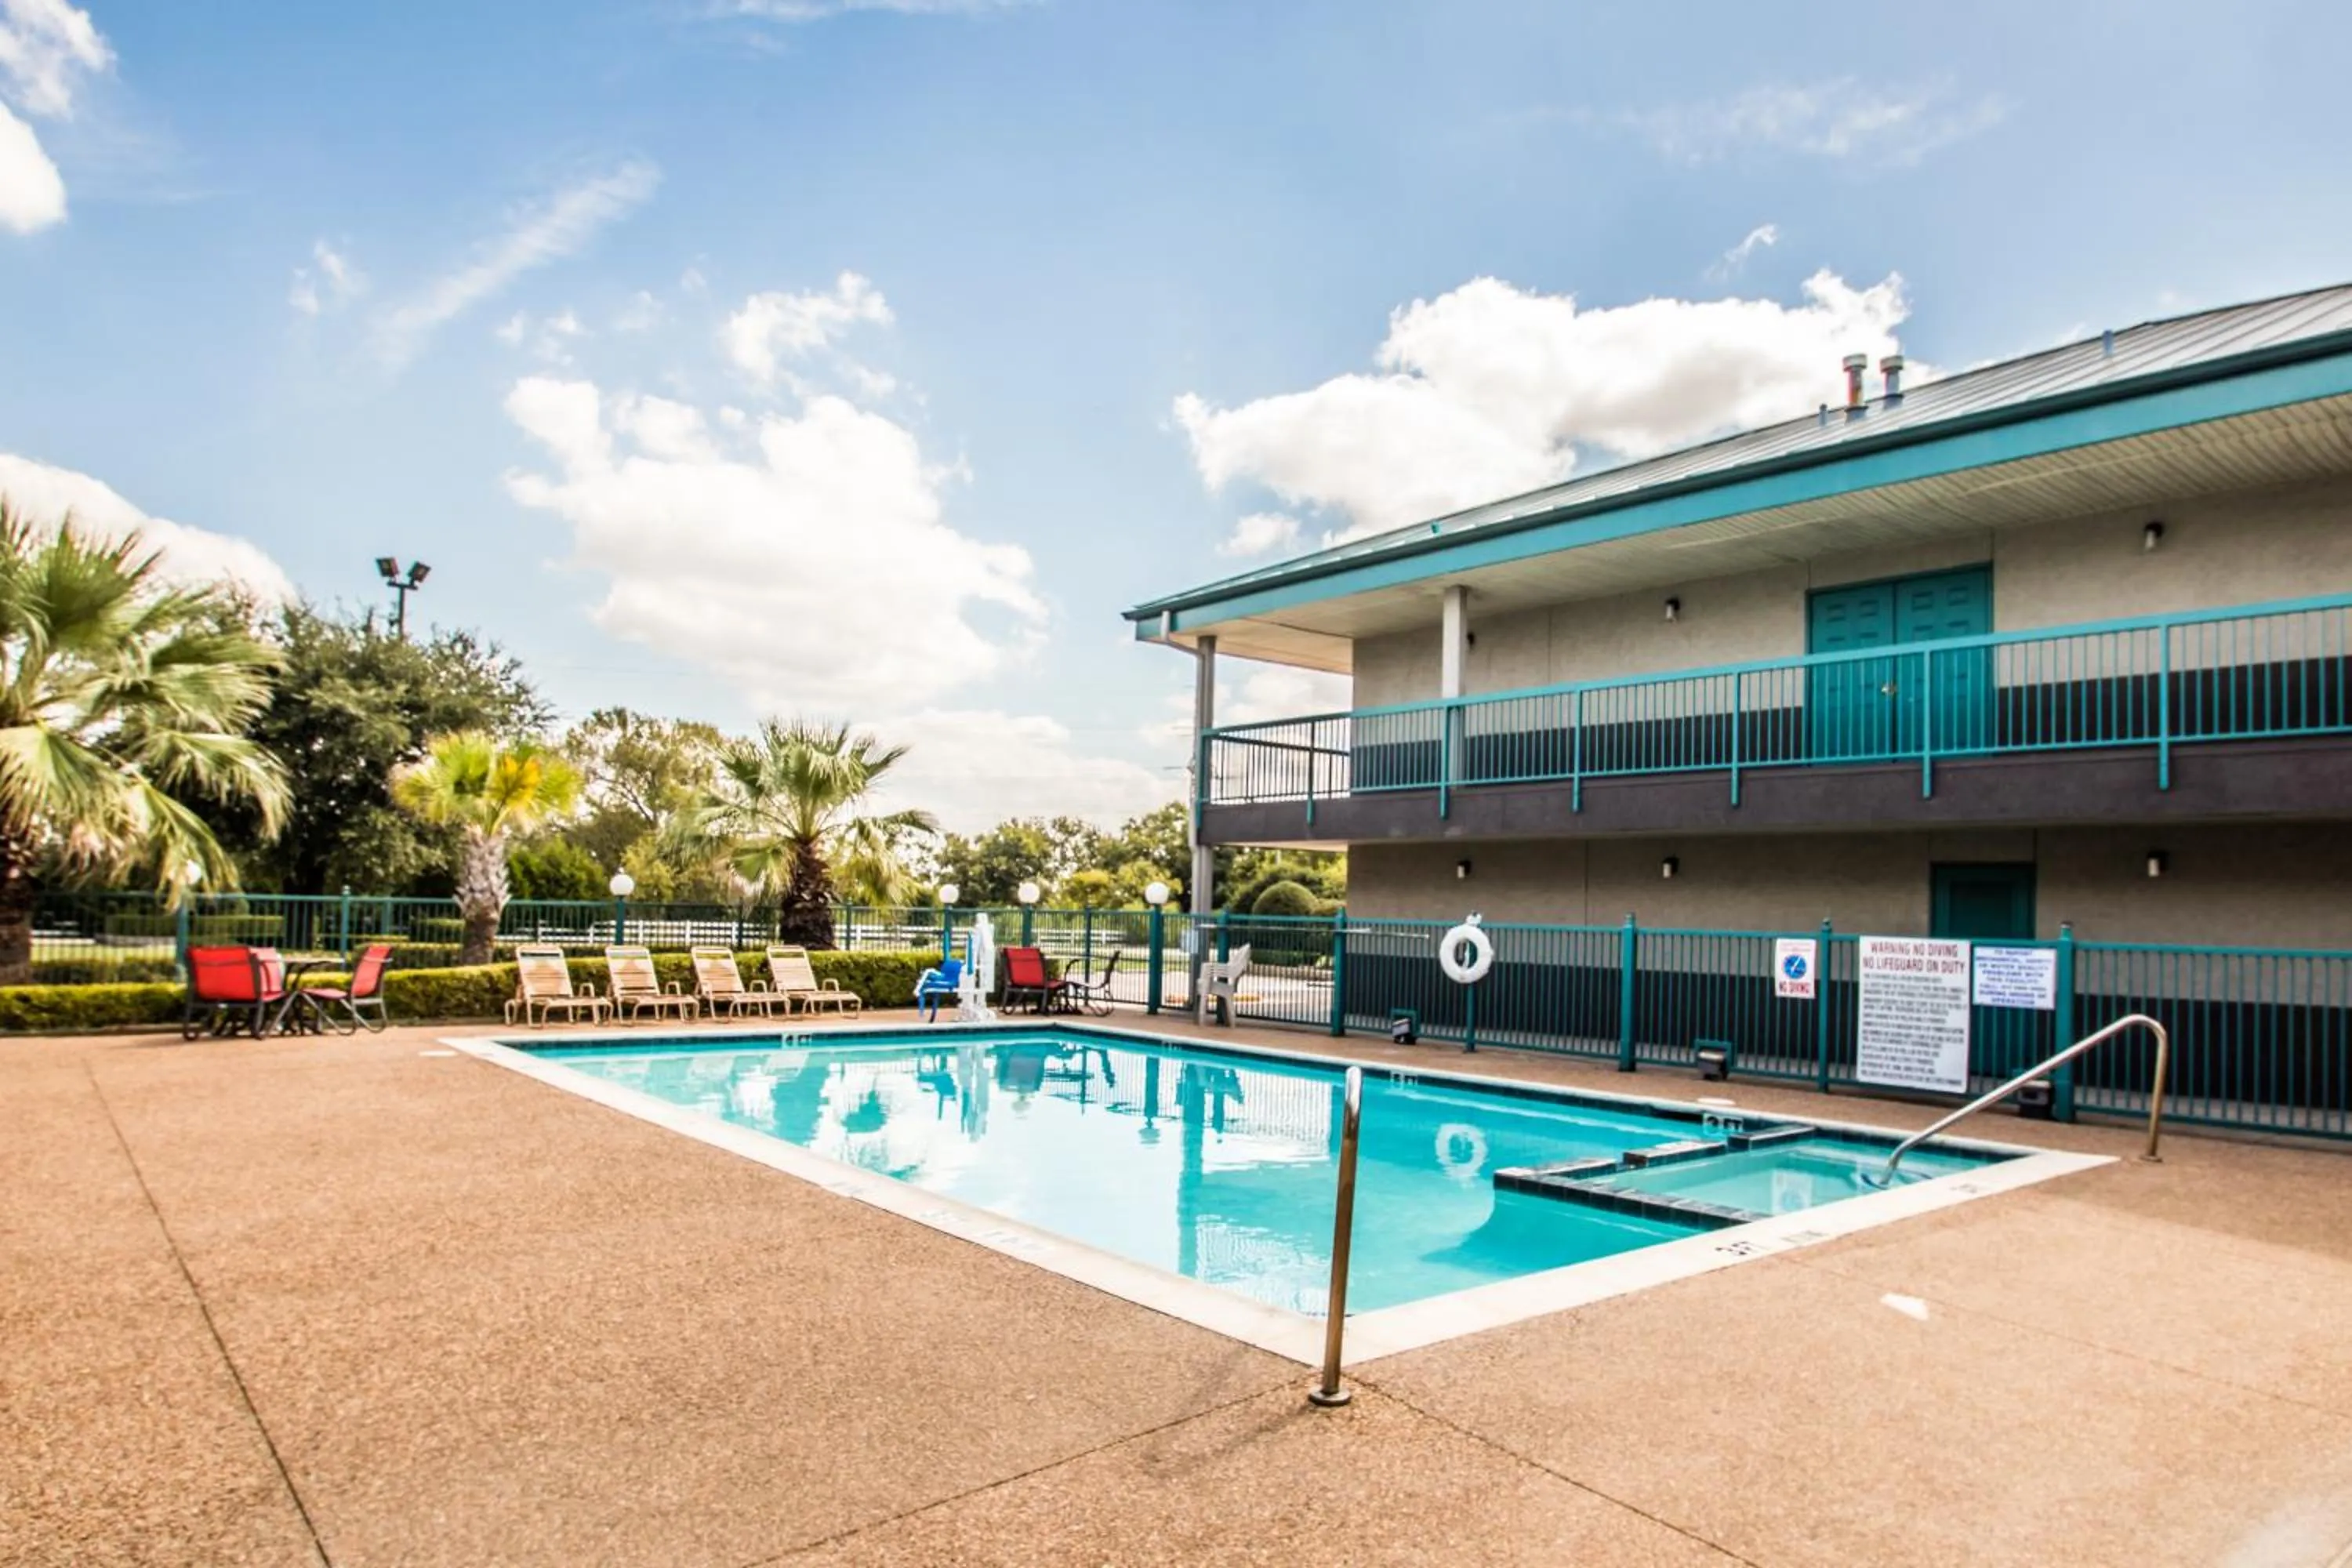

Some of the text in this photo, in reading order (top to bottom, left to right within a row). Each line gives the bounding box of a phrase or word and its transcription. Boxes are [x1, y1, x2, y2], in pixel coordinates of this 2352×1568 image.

[1871, 941, 1958, 957] WARNING NO DIVING
[1863, 956, 1965, 974] NO LIFEGUARD ON DUTY
[1779, 981, 1787, 993] NO
